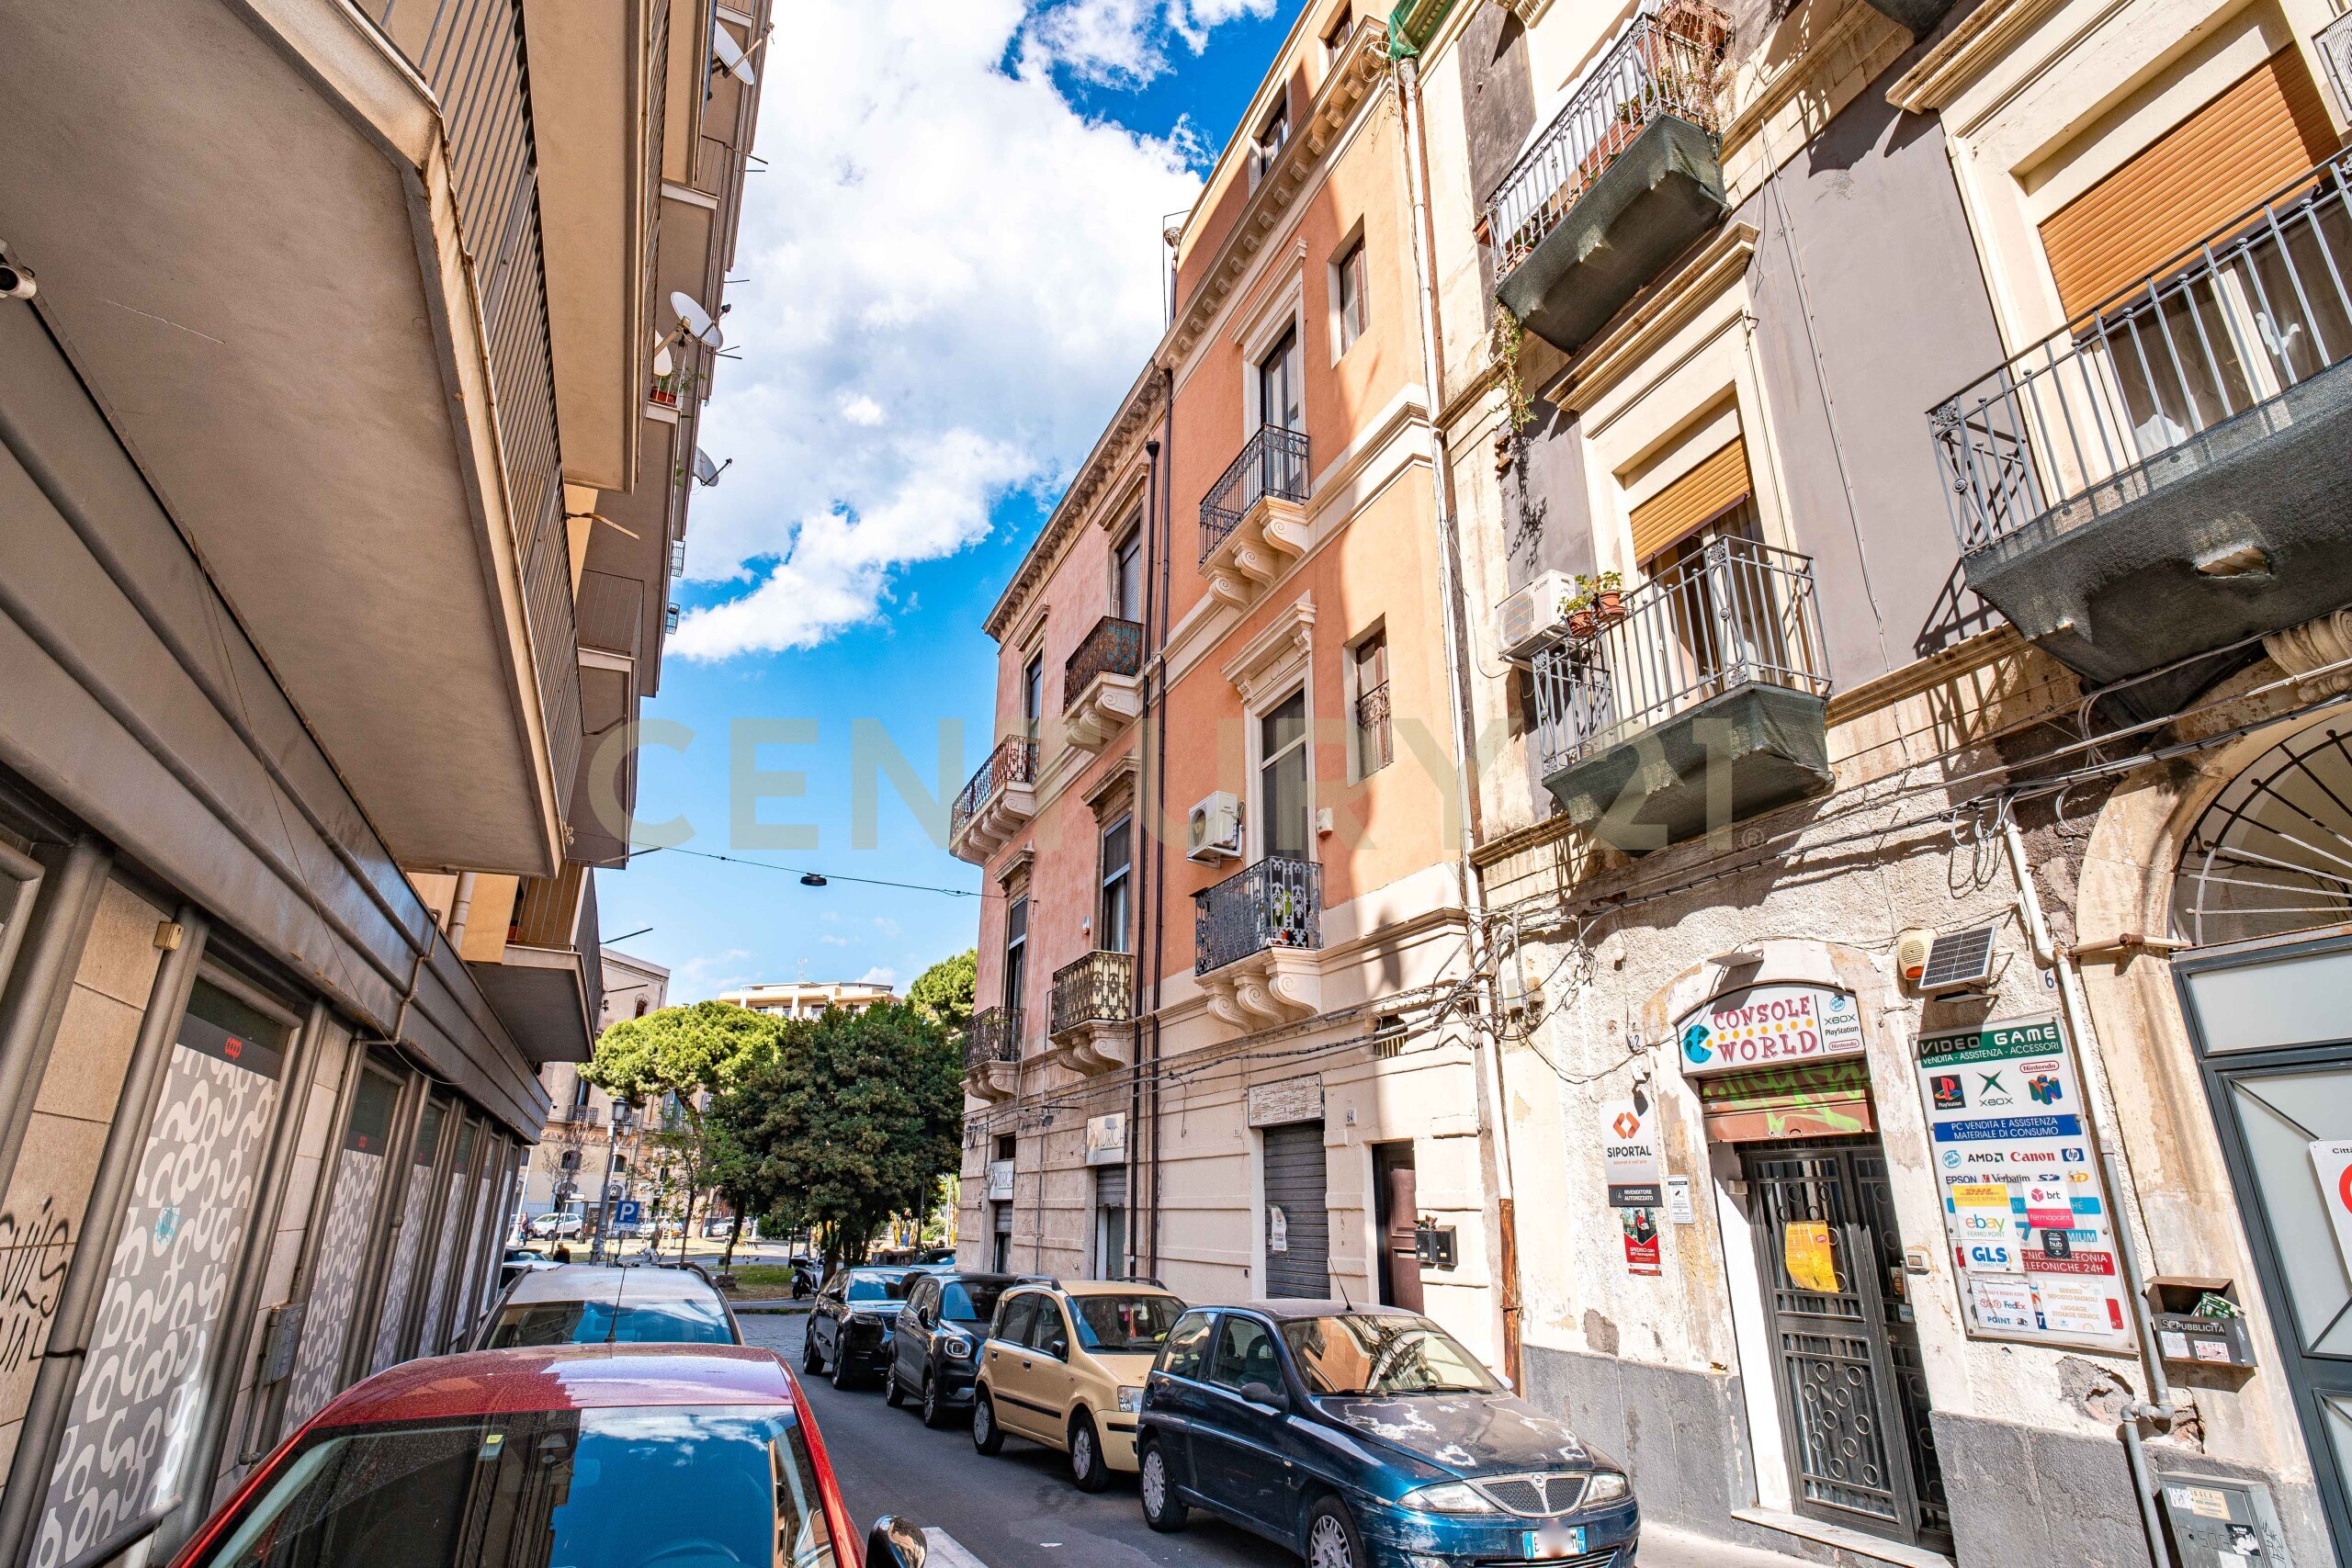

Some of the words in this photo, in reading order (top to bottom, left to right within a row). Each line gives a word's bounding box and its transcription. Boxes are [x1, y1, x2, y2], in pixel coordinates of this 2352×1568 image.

[1713, 996, 1810, 1031] CONSOLE
[1824, 1013, 1856, 1025] XBOX
[1825, 1026, 1860, 1036] PlayStation
[1831, 1041, 1857, 1049] Nintendo
[1920, 1036, 1981, 1055] VIDEO
[1994, 1026, 2057, 1045] GAME
[1717, 1030, 1818, 1064] WORLD
[1923, 1054, 1953, 1065] VENDITA
[1960, 1048, 2003, 1060] ASSISTENZA
[2010, 1042, 2059, 1055] ACCESSORI
[2023, 1063, 2056, 1071] Nintendo
[1979, 1097, 2014, 1107] XBOX
[1951, 1122, 1962, 1131] PC
[1965, 1121, 1999, 1130] VENDITA
[2001, 1120, 2006, 1128] E
[2008, 1117, 2058, 1128] ASSISTENZA
[1953, 1130, 1996, 1140] MATERIALE
[1999, 1129, 2008, 1137] DI
[2010, 1127, 2059, 1137] CONSUMO
[1607, 1145, 1652, 1157] SIPORTAL
[2068, 1148, 2078, 1161] hp
[1968, 1153, 1994, 1162] AMD
[2010, 1151, 2055, 1162] Canon
[1945, 1176, 1977, 1185] EPSON
[1991, 1173, 2030, 1183] Verbatim
[2046, 1190, 2061, 1200] brt
[619, 1202, 636, 1221] P
[1965, 1213, 2005, 1232] ebay
[2030, 1213, 2071, 1222] fermopoint
[1972, 1247, 2007, 1263] GLS
[2083, 1264, 2104, 1273] 24H
[2003, 1300, 2027, 1309] FedEx
[1986, 1315, 2010, 1324] POINT
[2177, 1323, 2225, 1333] PUBBLICITÀ
